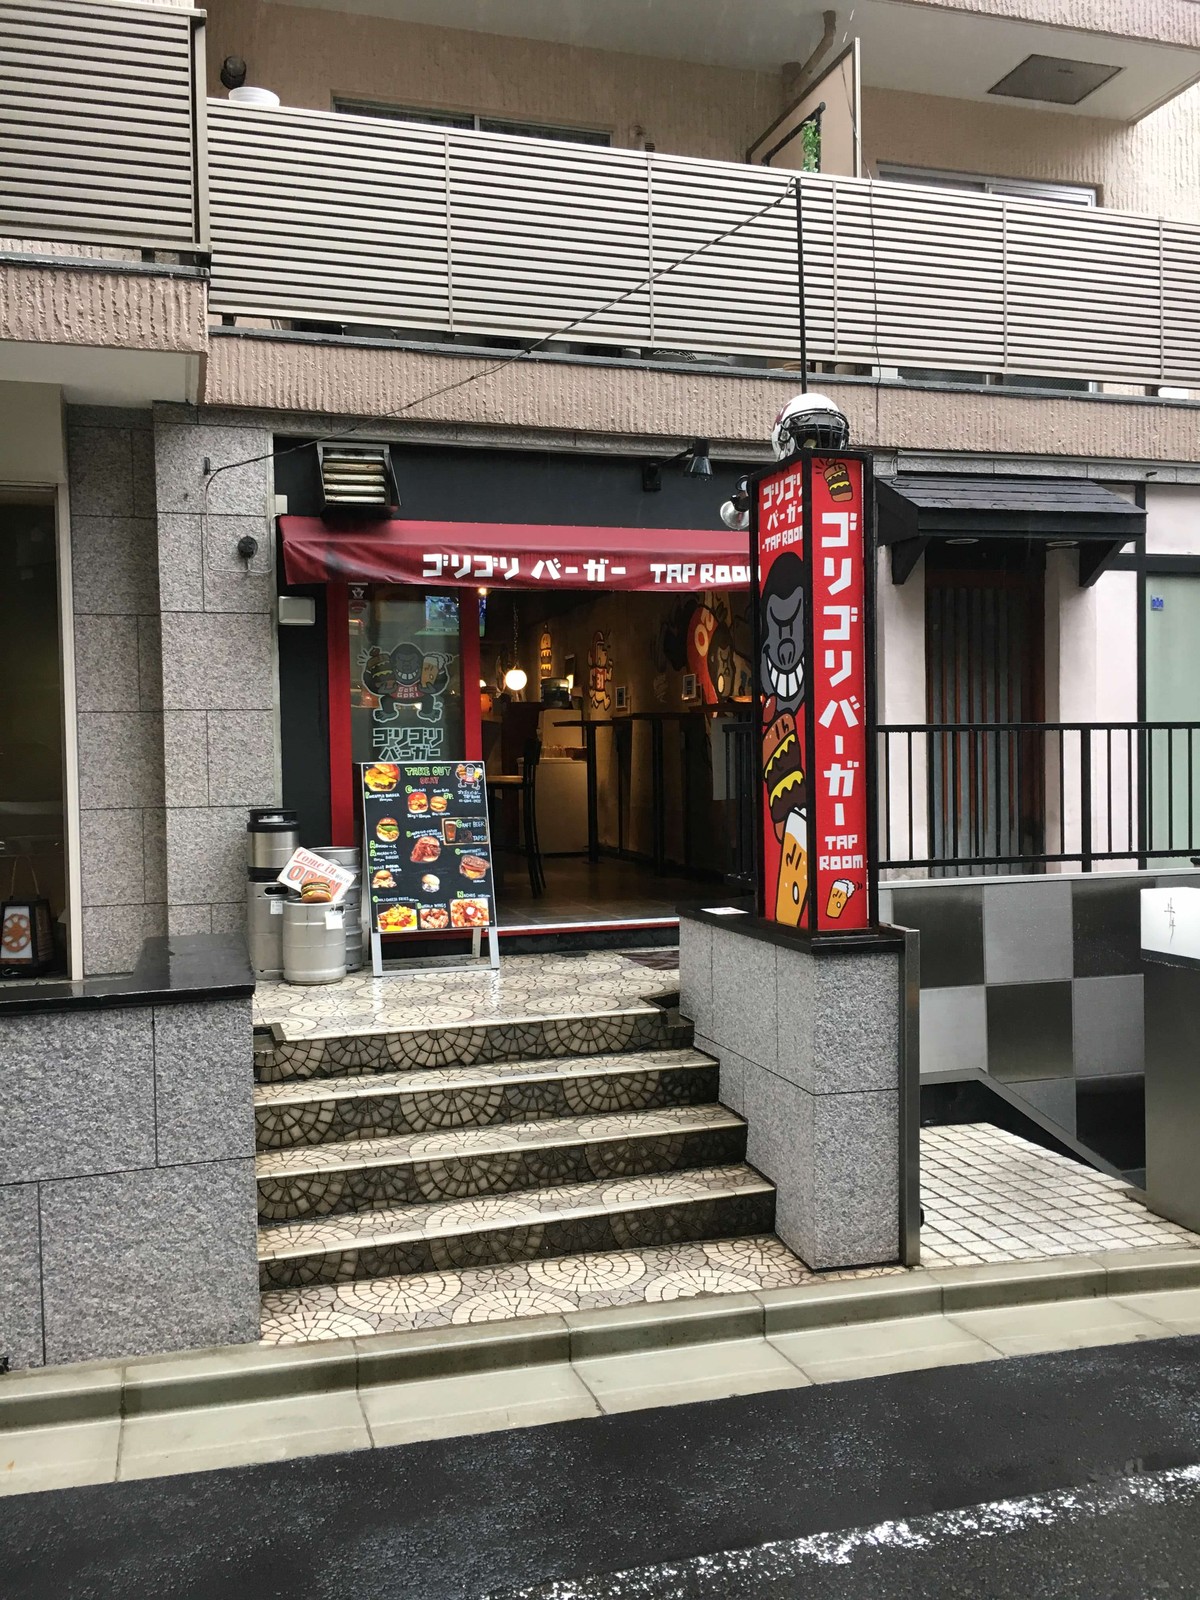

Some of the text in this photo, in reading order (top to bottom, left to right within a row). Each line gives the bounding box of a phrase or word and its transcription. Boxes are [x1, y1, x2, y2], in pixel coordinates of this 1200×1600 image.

[423, 553, 626, 582] ゴリゴリ バーガー
[650, 563, 696, 584] TAP
[818, 511, 859, 826] ゴリゴリバーガー
[373, 728, 443, 747] ゴリゴリ
[379, 746, 440, 761] バーガー
[404, 766, 451, 776] TAKE OUT
[825, 834, 858, 850] TAP
[296, 850, 337, 875] Come in
[819, 854, 863, 871] ROOM
